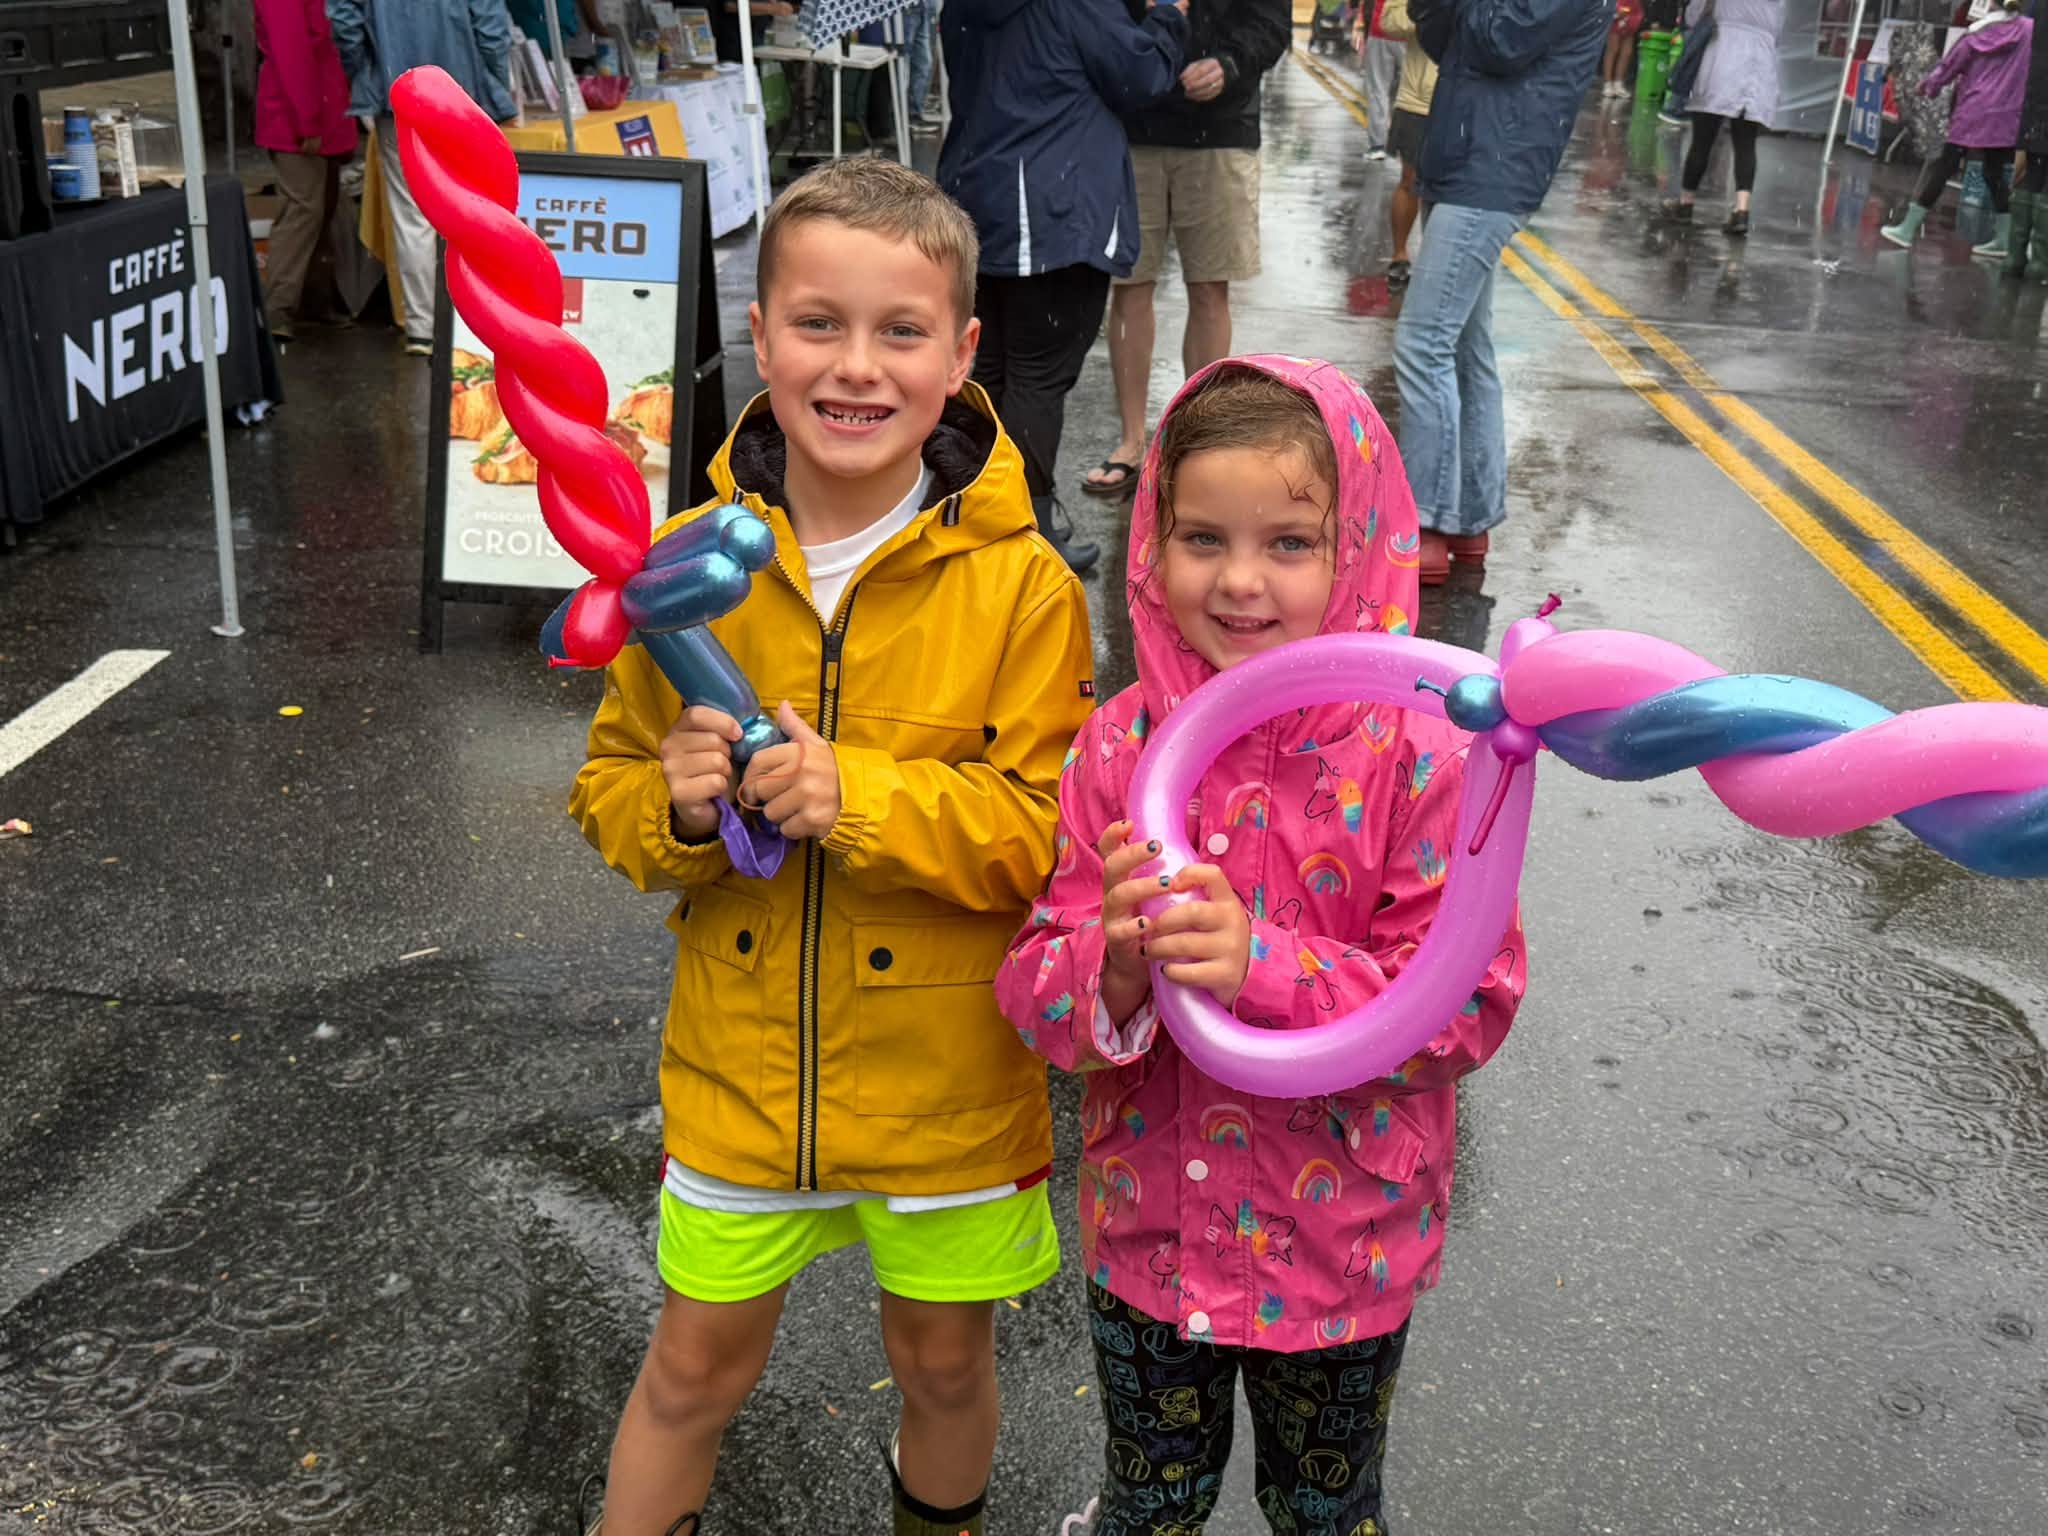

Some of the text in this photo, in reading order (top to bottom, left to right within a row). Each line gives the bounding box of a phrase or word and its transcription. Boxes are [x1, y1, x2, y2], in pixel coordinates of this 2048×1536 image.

[535, 195, 607, 214] CAFFÈ
[518, 216, 647, 256] ERO
[109, 227, 185, 295] CAFFÈ
[562, 309, 580, 320] EW
